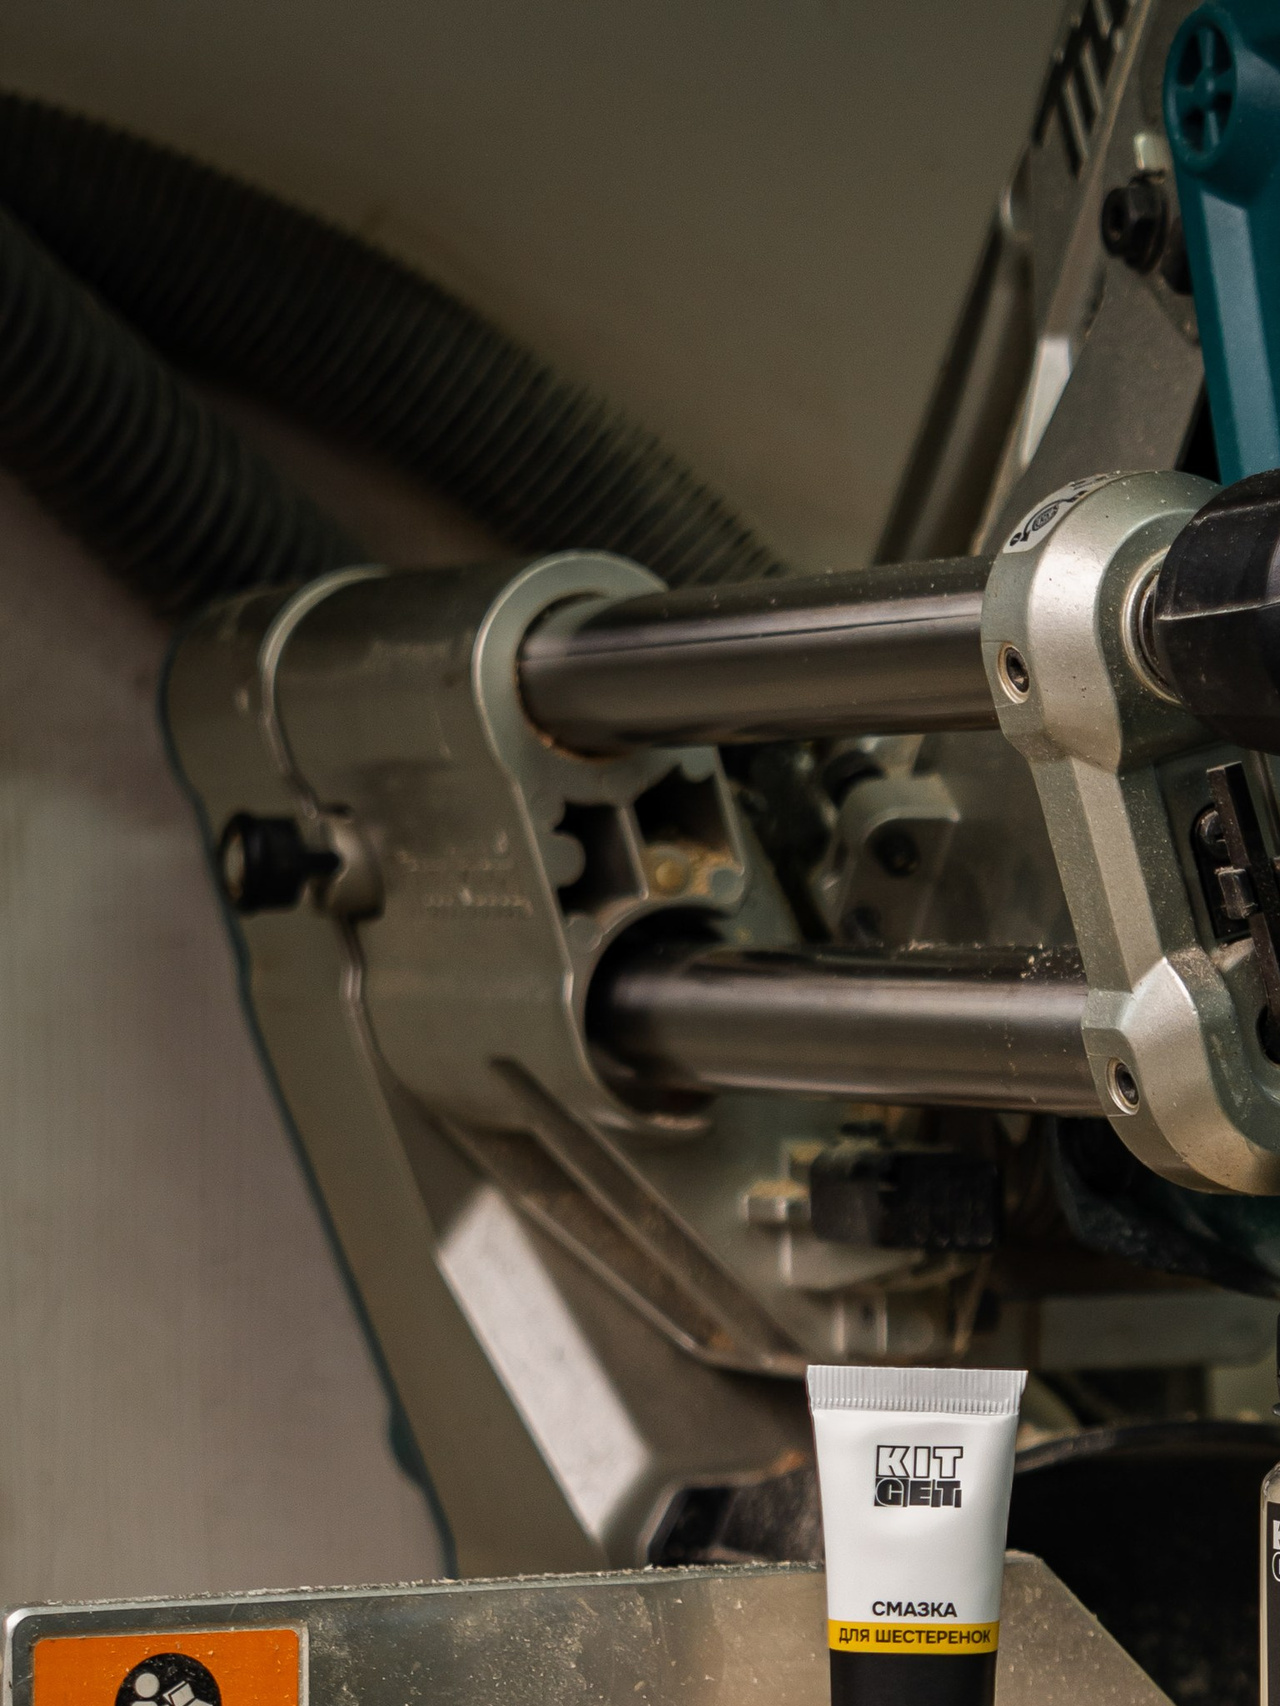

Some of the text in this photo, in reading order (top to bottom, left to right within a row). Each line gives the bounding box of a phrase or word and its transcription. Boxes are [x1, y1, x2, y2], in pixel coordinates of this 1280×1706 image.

[876, 1444, 964, 1479] KIT
[873, 1477, 963, 1508] GET
[871, 1600, 958, 1618] СМАЗКА
[839, 1627, 991, 1644] ДЛЯ ШЕСТЕРЕНОК
